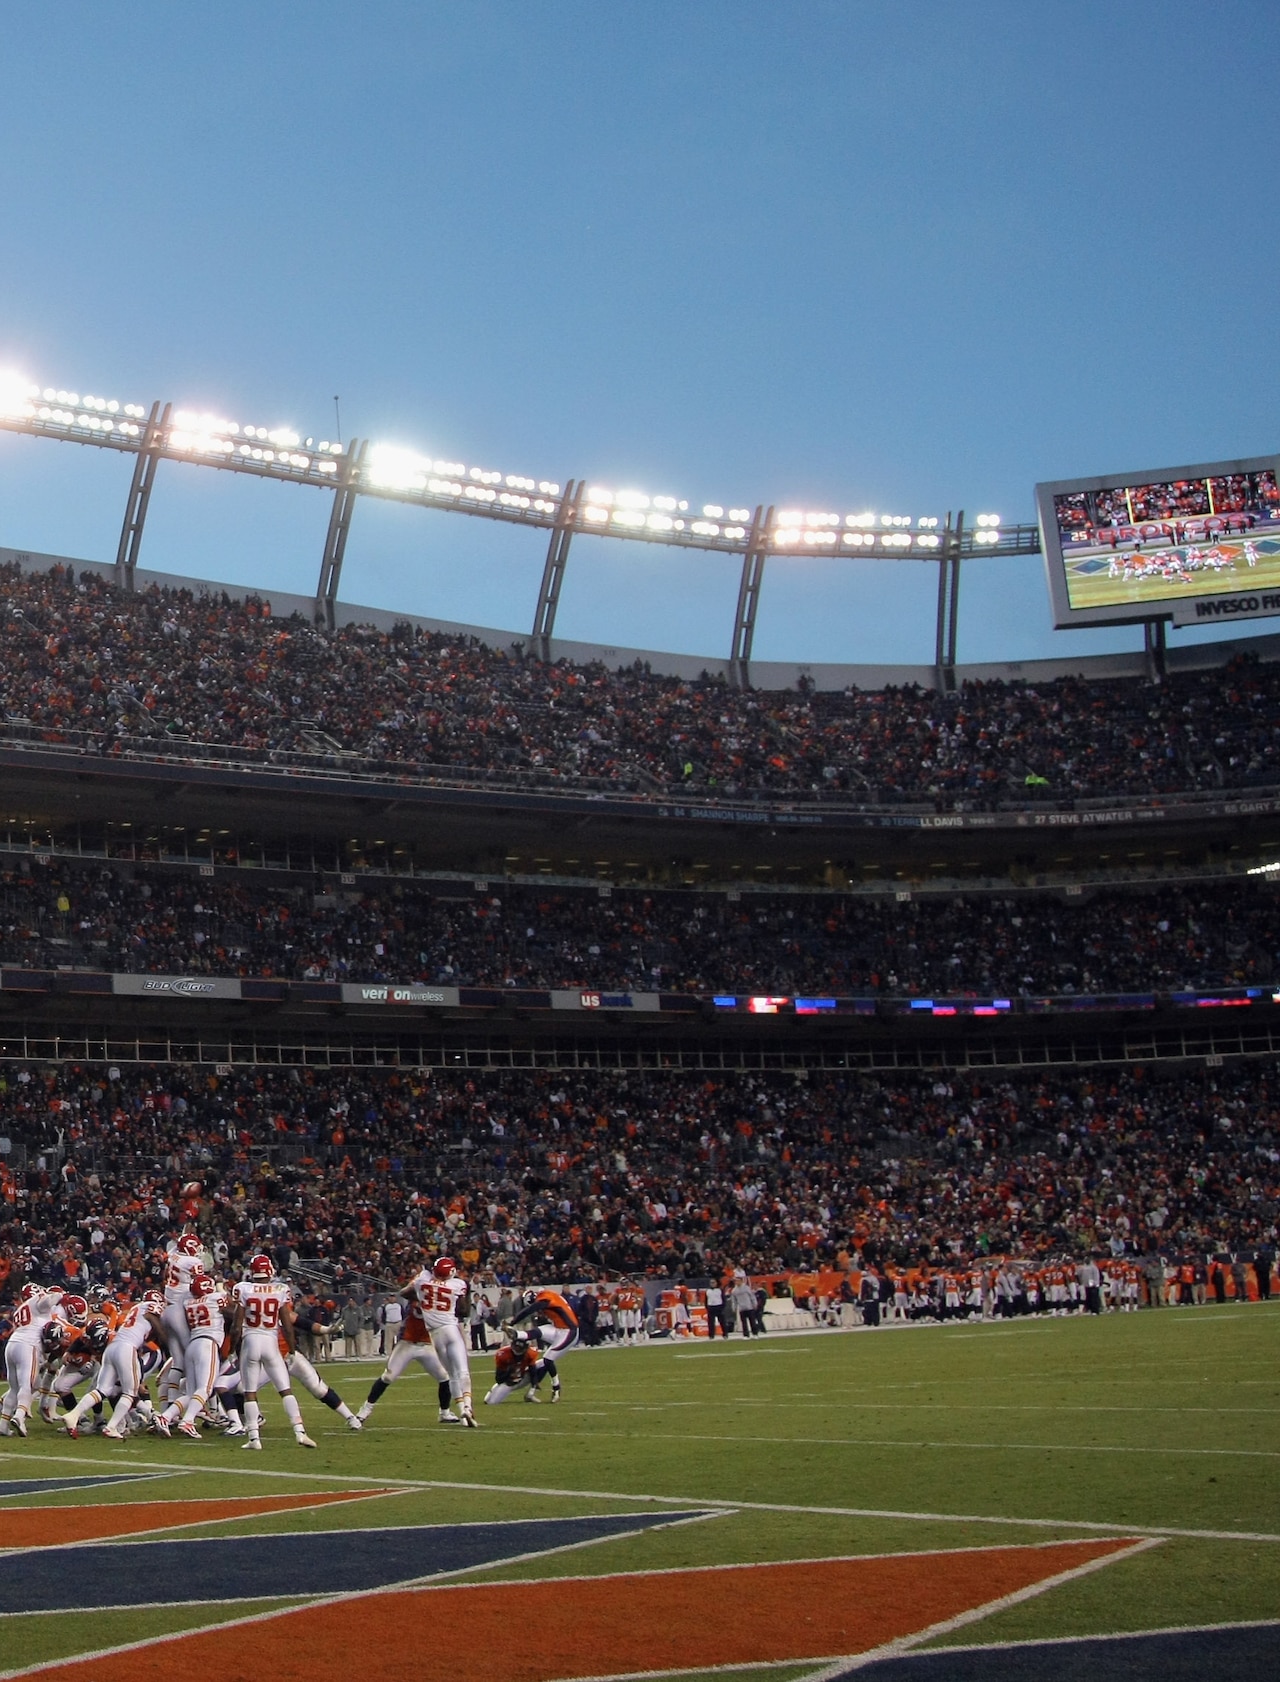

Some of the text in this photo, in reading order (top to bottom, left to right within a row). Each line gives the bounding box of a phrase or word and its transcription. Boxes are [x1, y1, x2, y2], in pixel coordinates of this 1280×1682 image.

[1071, 530, 1087, 541] 25
[1195, 596, 1259, 617] INVESCO
[690, 808, 735, 821] SHANNON
[735, 811, 770, 823] SHARPE
[892, 816, 932, 827] TERRELL
[933, 816, 964, 827] DAVIS
[1035, 814, 1046, 823] 27
[1048, 813, 1081, 823] STEVE
[1082, 811, 1133, 822] ATWATER
[420, 1283, 452, 1311] 35
[246, 1297, 279, 1328] 39
